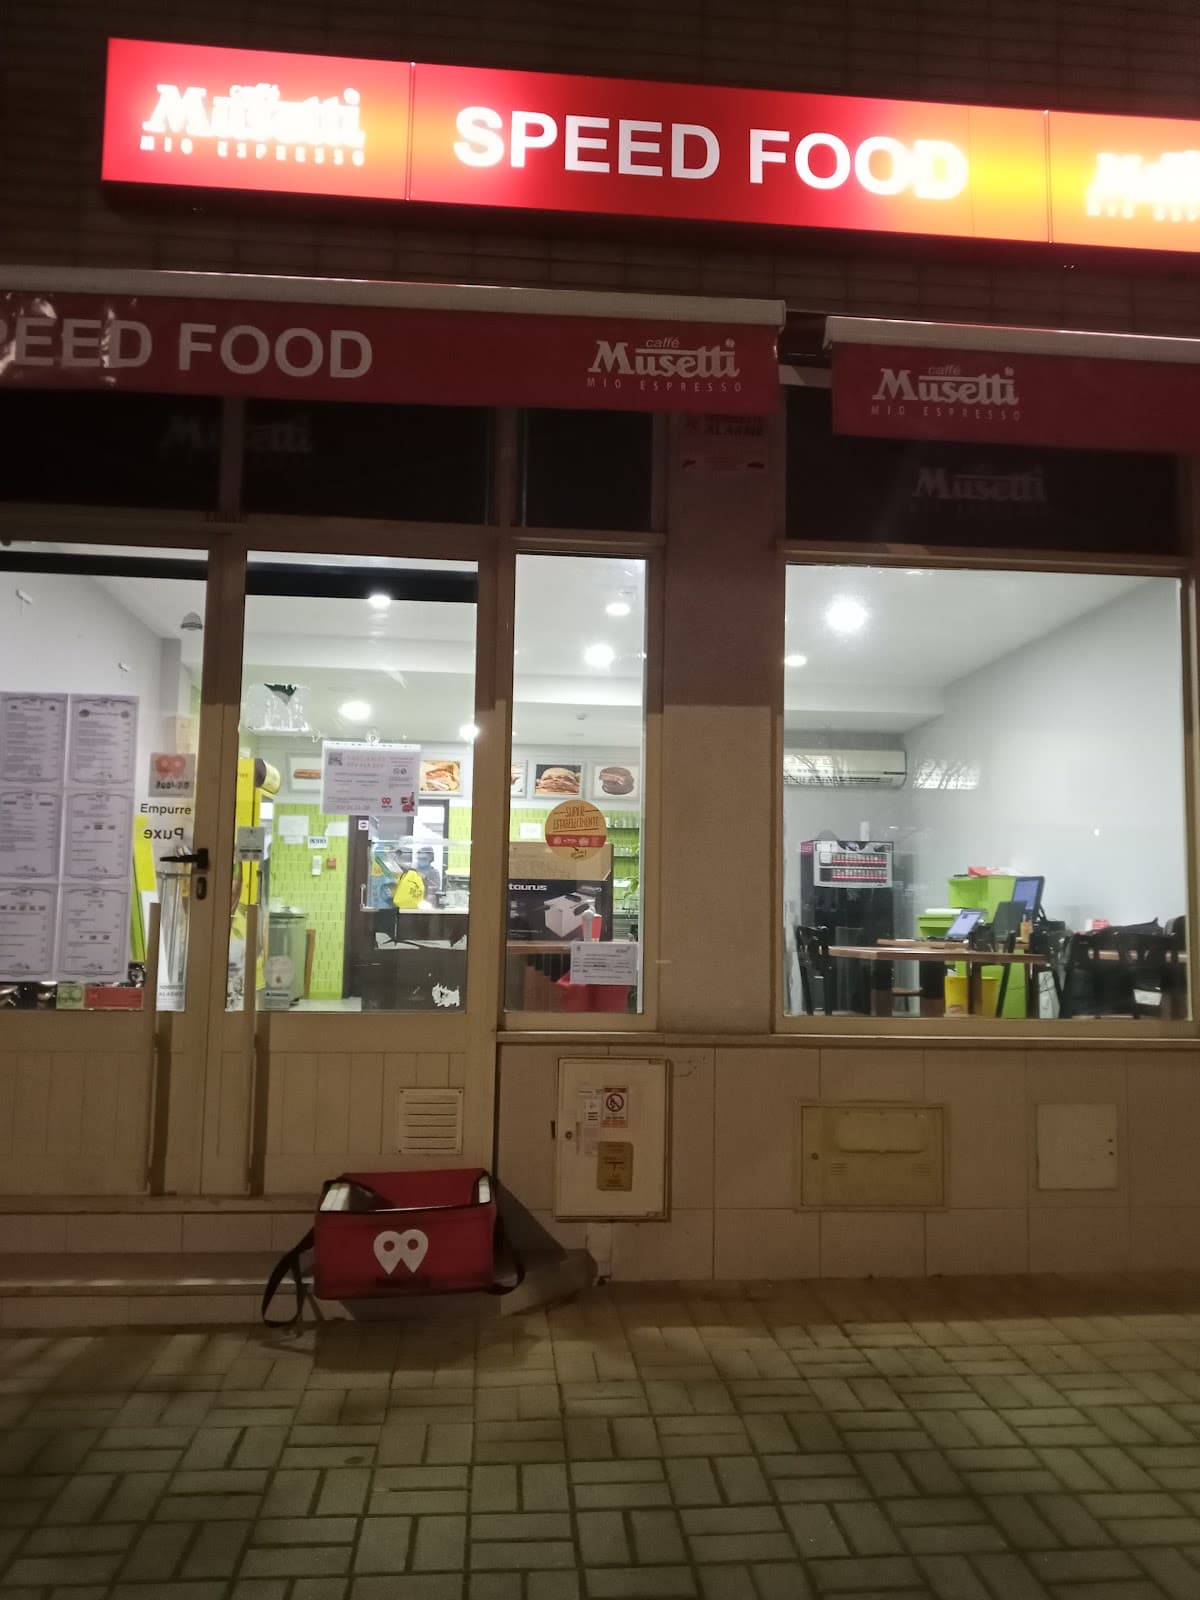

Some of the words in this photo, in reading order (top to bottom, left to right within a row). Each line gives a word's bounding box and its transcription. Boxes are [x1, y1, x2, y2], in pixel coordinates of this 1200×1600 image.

[453, 106, 720, 180] SPEED
[749, 128, 969, 200] FOOD
[0, 317, 152, 368] EED
[179, 323, 373, 379] FOOD
[587, 338, 741, 378] Musetti
[586, 377, 622, 389] MIO
[640, 379, 742, 392] ESPRESSO
[871, 366, 1019, 406] Musetti
[871, 405, 905, 416] MIO
[923, 406, 1021, 421] ESPRESSO
[160, 414, 312, 453] Muetti
[911, 465, 1047, 503] Musetti
[140, 803, 192, 816] Empurre
[508, 883, 547, 891] taurus
